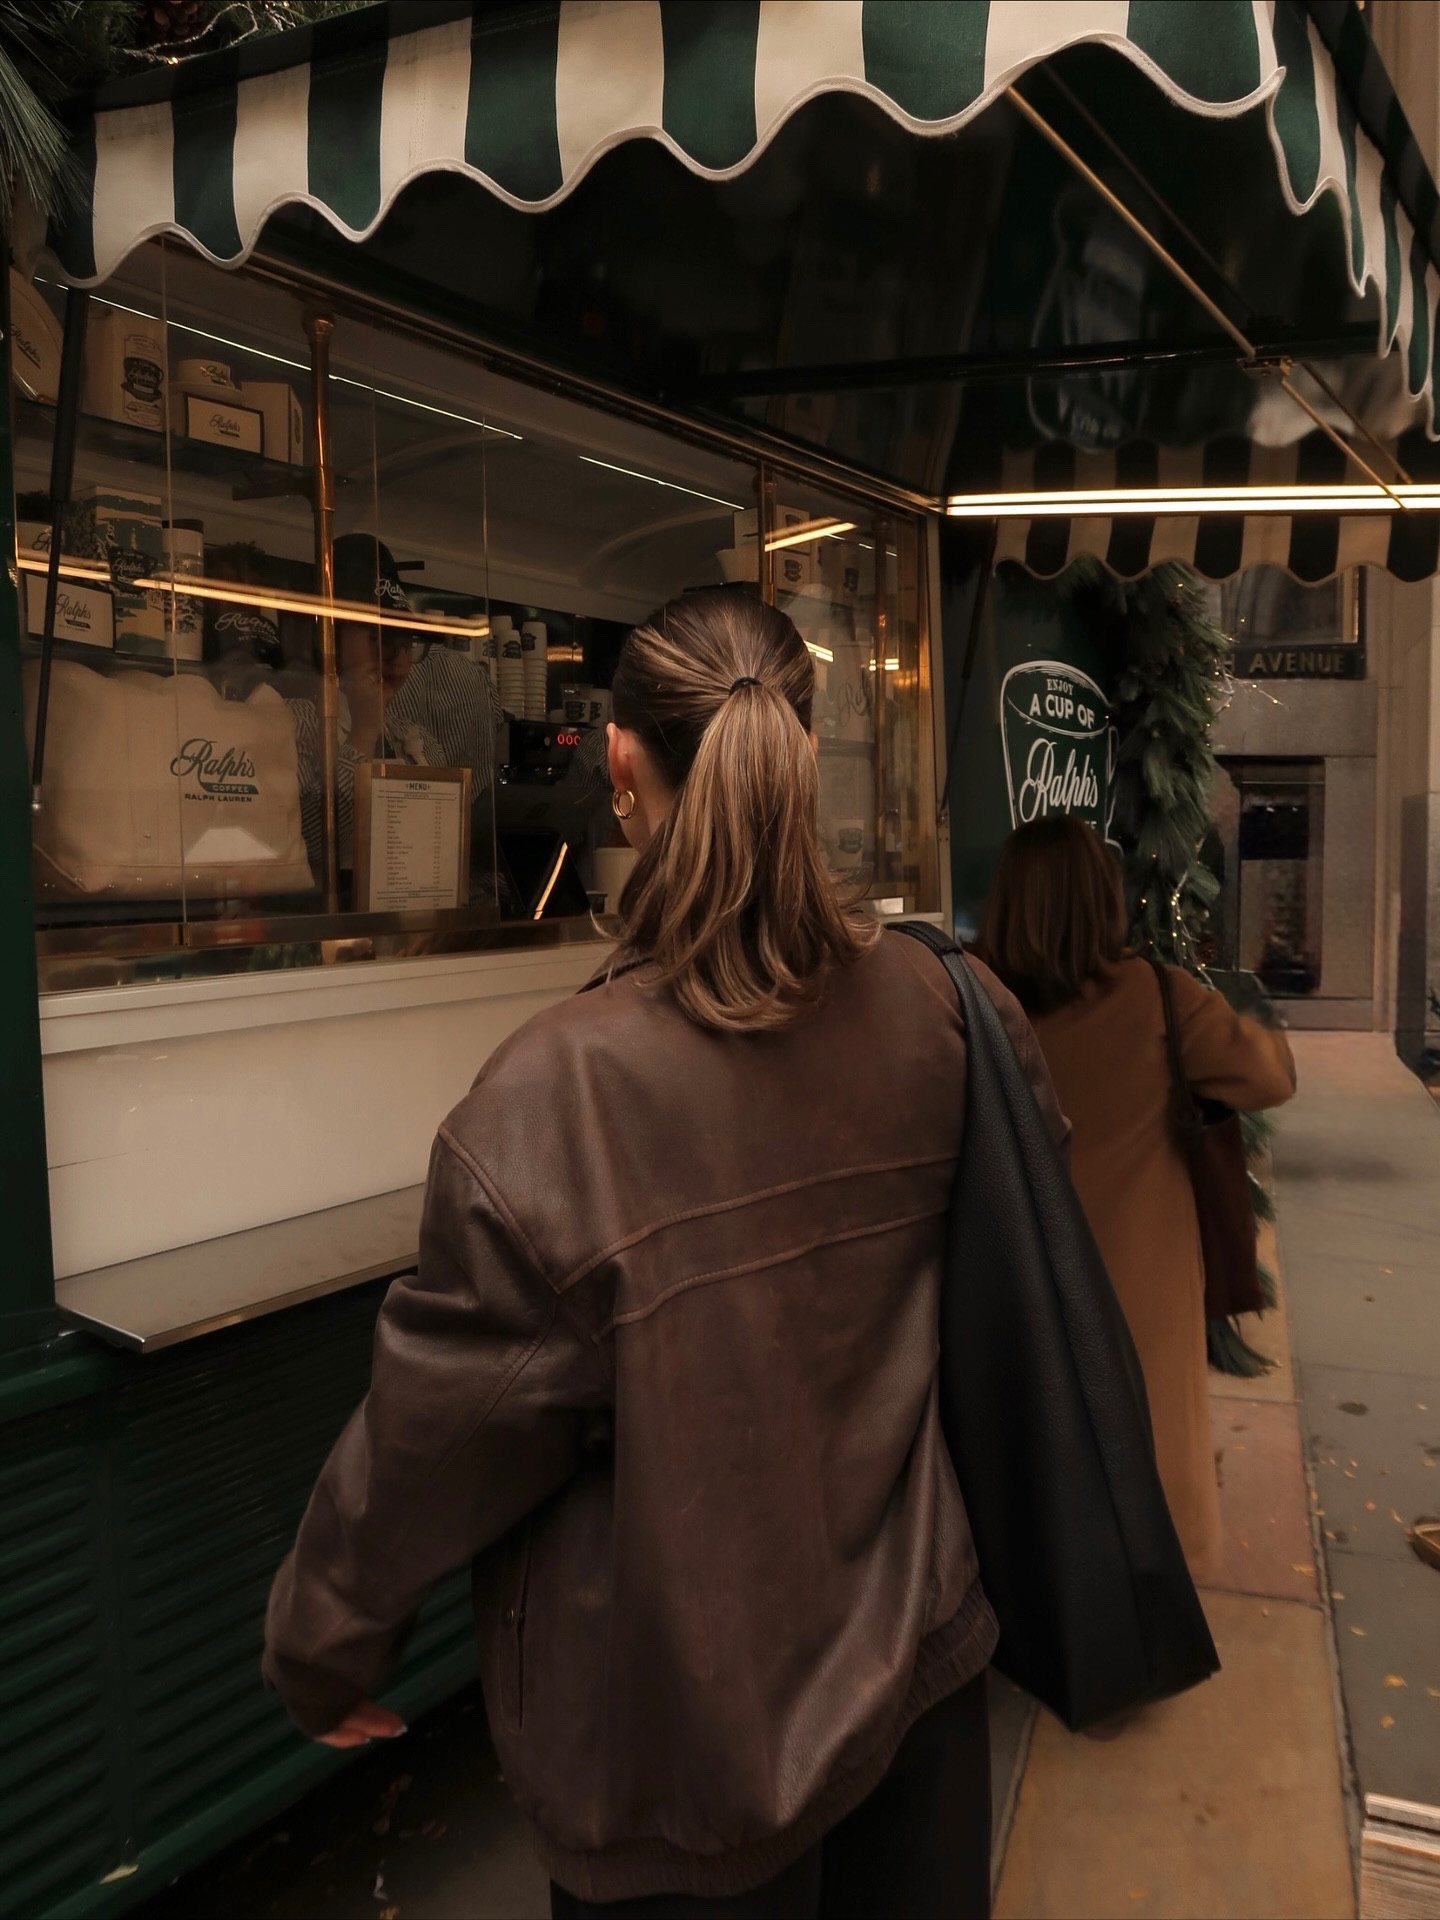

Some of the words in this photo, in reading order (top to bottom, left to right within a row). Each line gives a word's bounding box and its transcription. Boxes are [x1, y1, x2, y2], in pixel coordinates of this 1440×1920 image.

[1248, 652, 1346, 673] AVENUE
[1046, 678, 1075, 696] ENJOY
[1028, 693, 1043, 717] A
[1045, 694, 1075, 720] CUP
[1077, 703, 1096, 730] OF
[170, 738, 256, 784] Ralph's
[211, 784, 250, 793] COFFEE
[409, 782, 428, 791] MENU
[1019, 737, 1099, 823] Ralph's
[184, 793, 215, 802] RALPH
[217, 795, 254, 803] LAUREN
